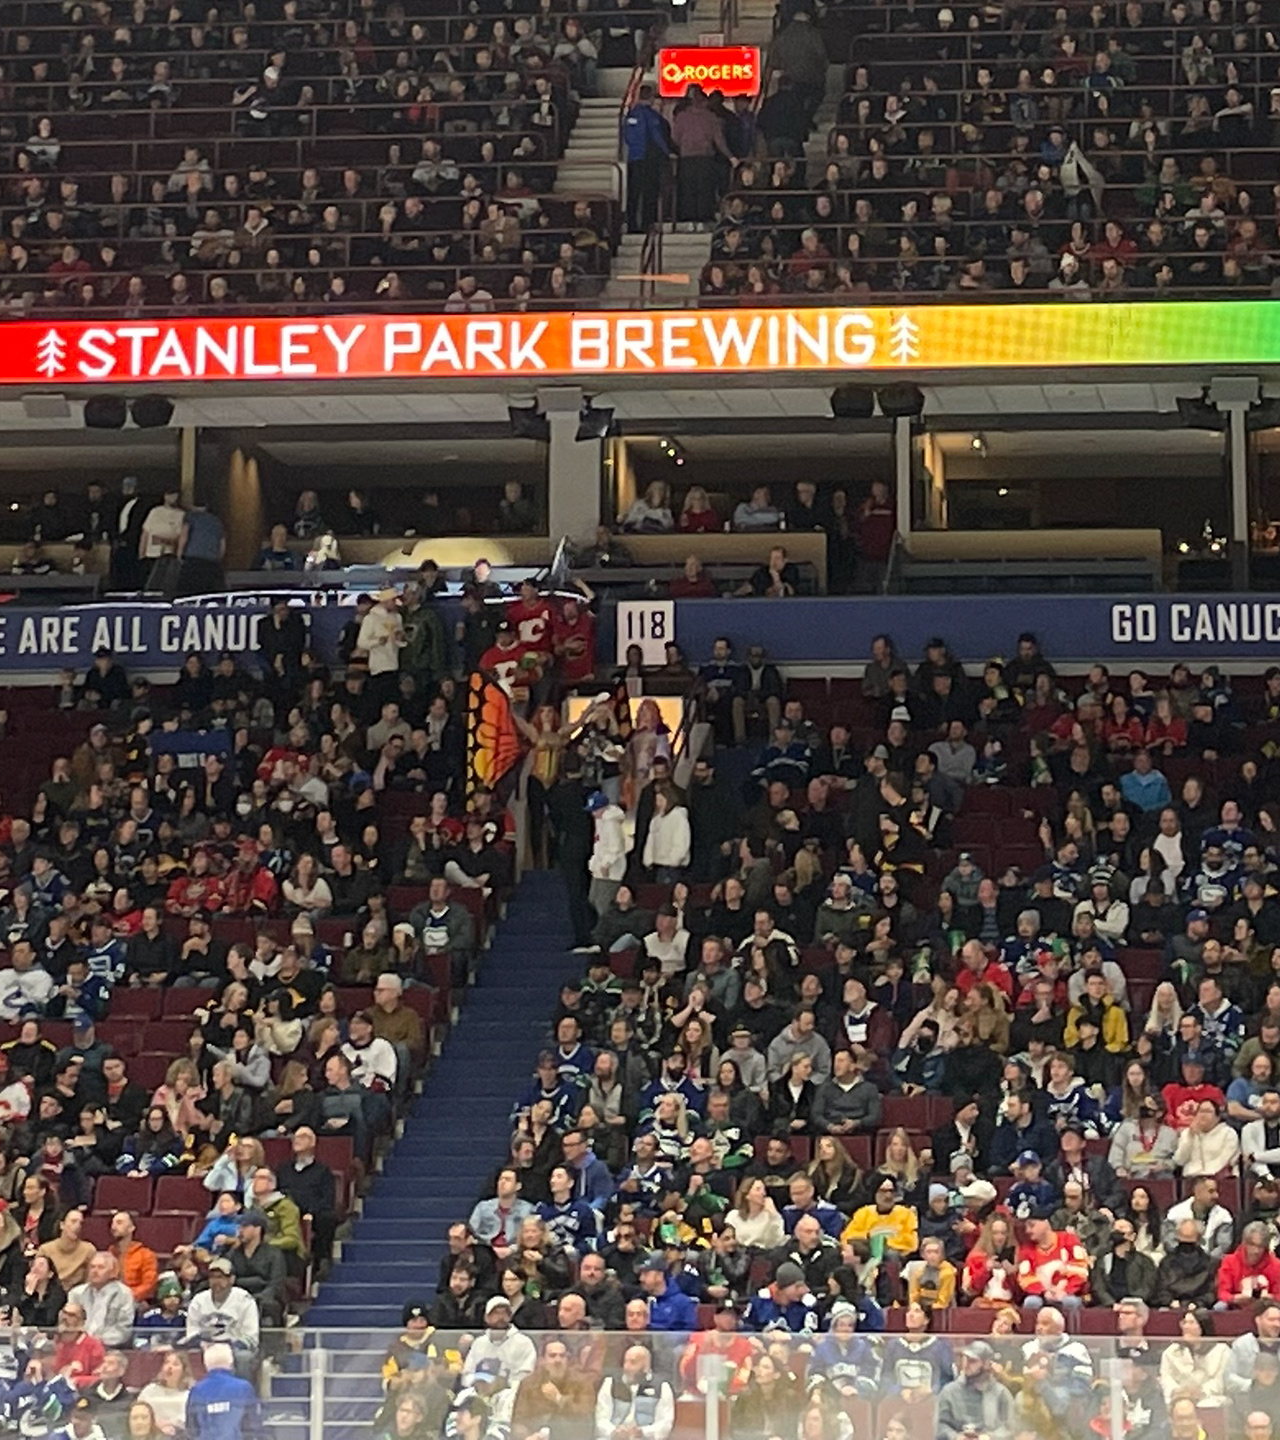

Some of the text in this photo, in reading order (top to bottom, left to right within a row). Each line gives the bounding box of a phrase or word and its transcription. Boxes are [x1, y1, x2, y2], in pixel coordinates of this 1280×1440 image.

[684, 63, 754, 81] ROGERS
[77, 313, 876, 378] STANLEY PARK BREWING
[18, 615, 80, 654] ARE
[91, 615, 148, 653] ALL
[627, 610, 666, 639] 118
[1111, 603, 1157, 642] GO
